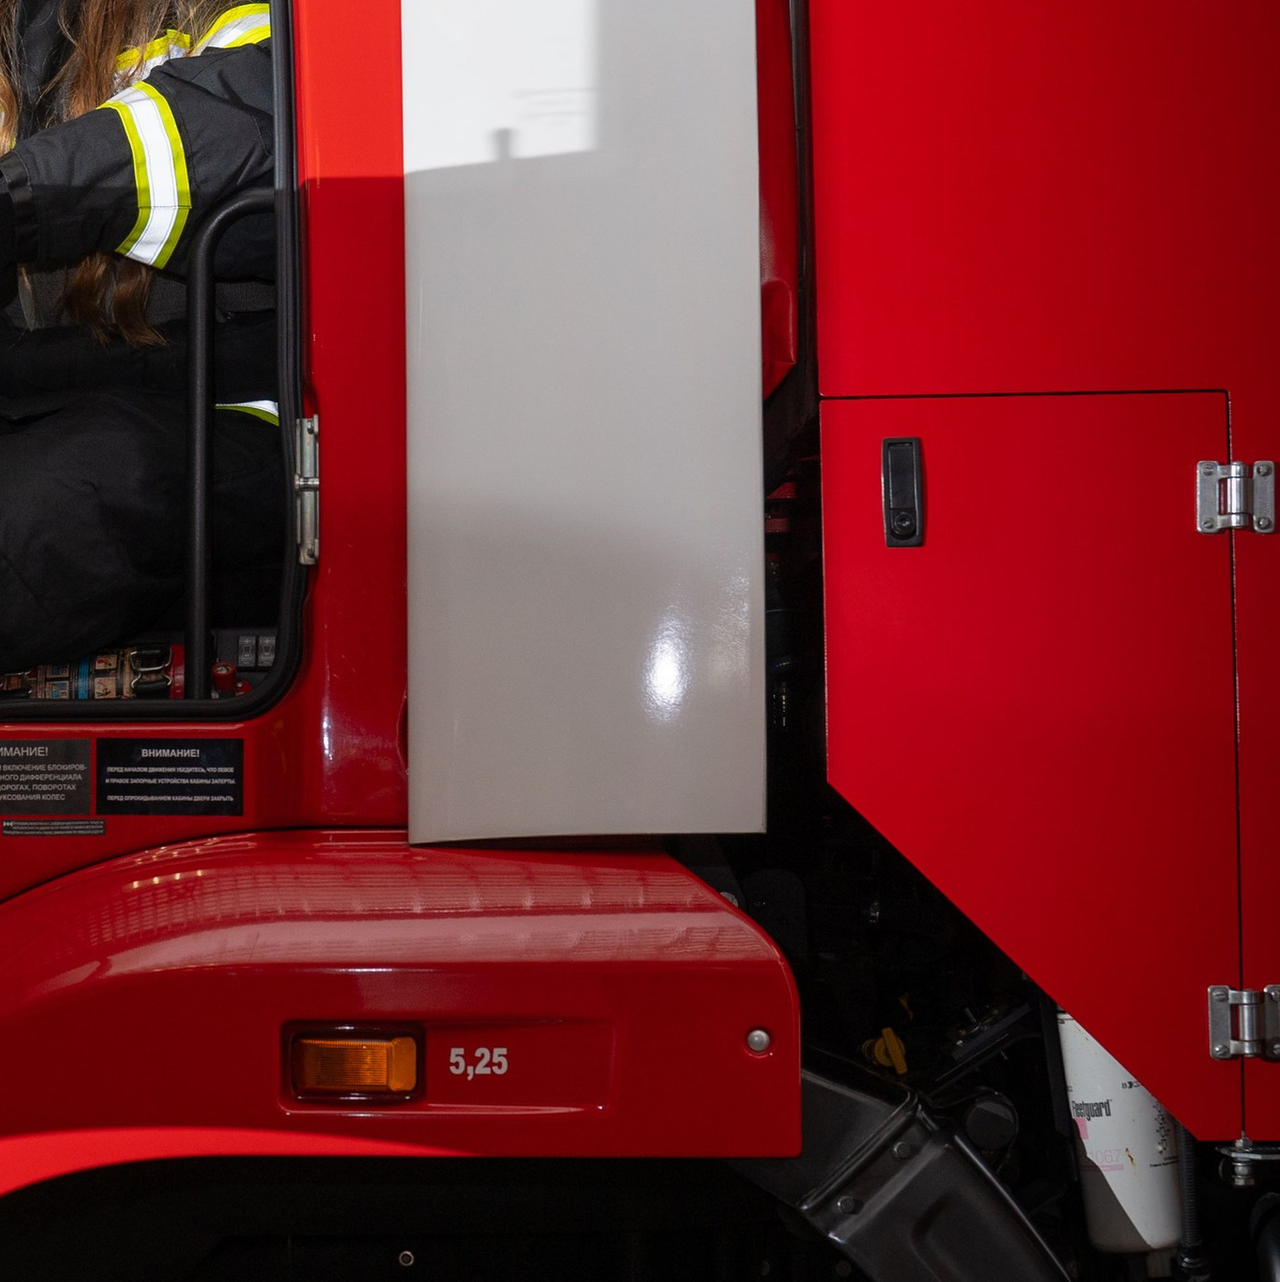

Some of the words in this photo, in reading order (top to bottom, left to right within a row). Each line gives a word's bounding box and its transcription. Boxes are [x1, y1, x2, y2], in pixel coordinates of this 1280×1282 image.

[141, 749, 200, 758] ВНИМАНИЕ!
[2, 764, 46, 772] ВКЛЮЧЕНИЕ
[47, 763, 87, 771] БЛОКИРОВ-
[449, 1047, 509, 1081] 5,25
